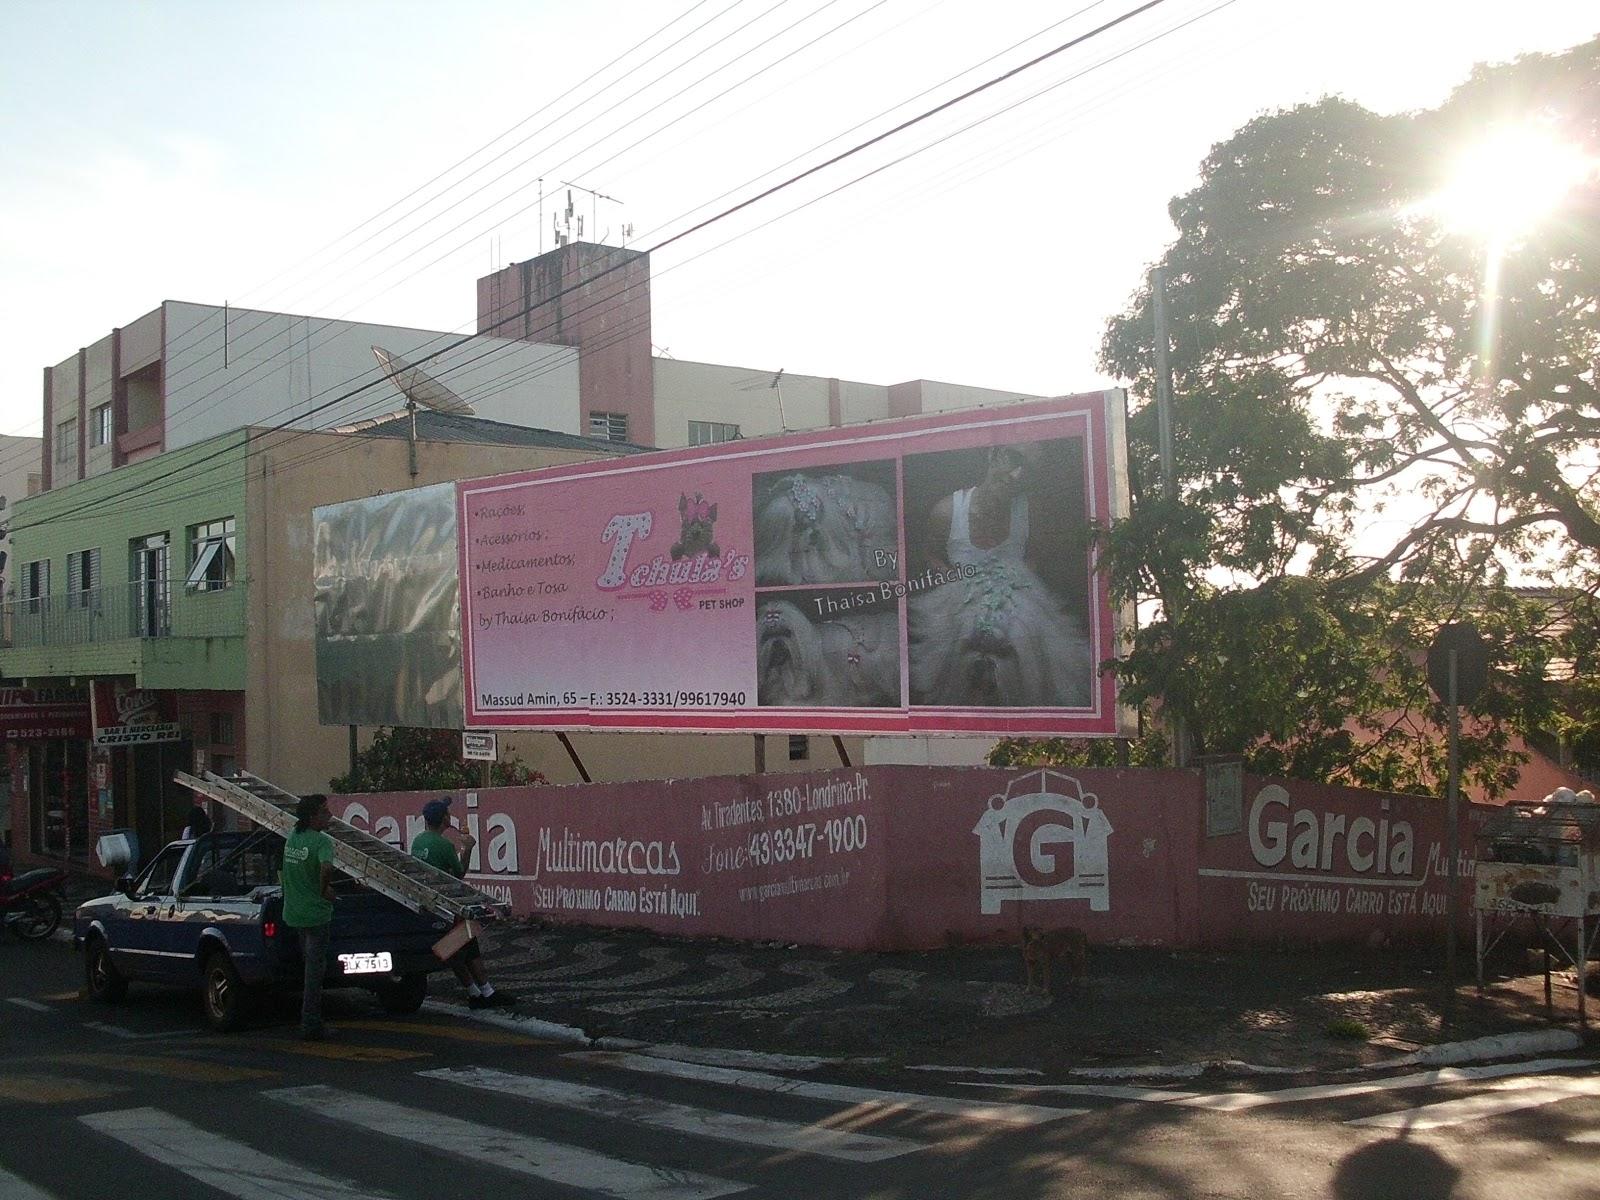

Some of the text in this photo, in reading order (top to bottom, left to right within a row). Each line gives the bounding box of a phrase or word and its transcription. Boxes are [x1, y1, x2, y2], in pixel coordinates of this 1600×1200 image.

[874, 549, 898, 570] By
[482, 580, 569, 600] Banho e Tosa
[699, 598, 745, 610] PET SHOP
[814, 590, 876, 616] Thaisa
[479, 613, 493, 630] by
[495, 611, 539, 626] Thaisa
[482, 693, 524, 707] Massud
[527, 692, 560, 707] Amin,
[563, 692, 577, 704] 65
[606, 691, 746, 708] 3524-3331/99617940
[98, 733, 151, 744] CRISTO
[342, 792, 518, 873] aria
[1248, 785, 1414, 876] Garcia
[538, 826, 681, 875] Multimarcas
[1012, 808, 1076, 887] G
[604, 886, 637, 911] CARRO
[1346, 887, 1384, 914] CARRO
[365, 958, 389, 970] 7513
